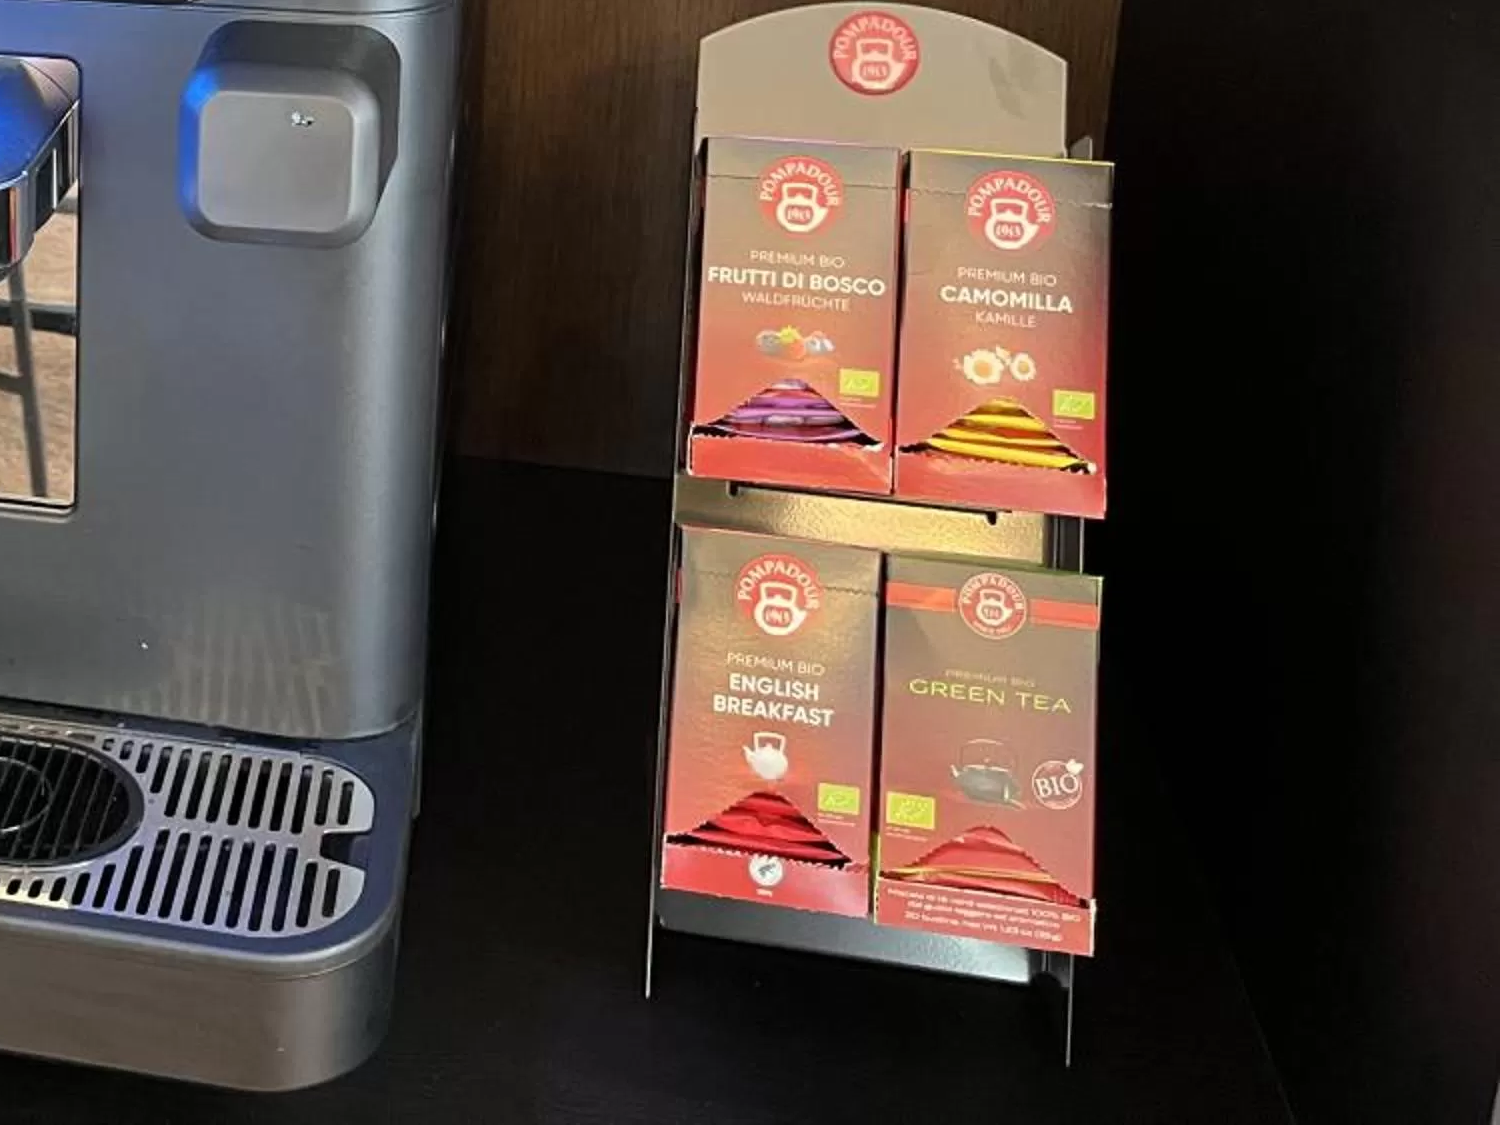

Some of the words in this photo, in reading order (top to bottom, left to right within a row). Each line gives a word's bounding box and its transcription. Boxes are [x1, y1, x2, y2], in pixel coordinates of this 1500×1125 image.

[832, 15, 918, 60] POMPADOUR
[759, 162, 843, 207] POMPADOUR
[967, 177, 1053, 224] POMPADOUR
[750, 250, 815, 266] PREMIUM
[819, 254, 846, 269] BIO
[707, 266, 776, 288] FRUTTI
[781, 271, 804, 289] DI
[808, 273, 886, 296] BOSCO
[957, 266, 1026, 285] PREMIUM
[1029, 273, 1057, 288] BIO
[939, 284, 1073, 314] CAMOMILLA
[975, 310, 1037, 328] KAMILLE
[737, 560, 821, 610] POMPADOUR
[726, 652, 794, 672] PREMIUM
[797, 661, 826, 676] BIO
[728, 672, 820, 702] ENGLISH
[909, 678, 1005, 706] GREEN
[1015, 691, 1072, 714] TEA
[712, 693, 835, 727] BREAKFAST
[1034, 772, 1079, 799] BIO
